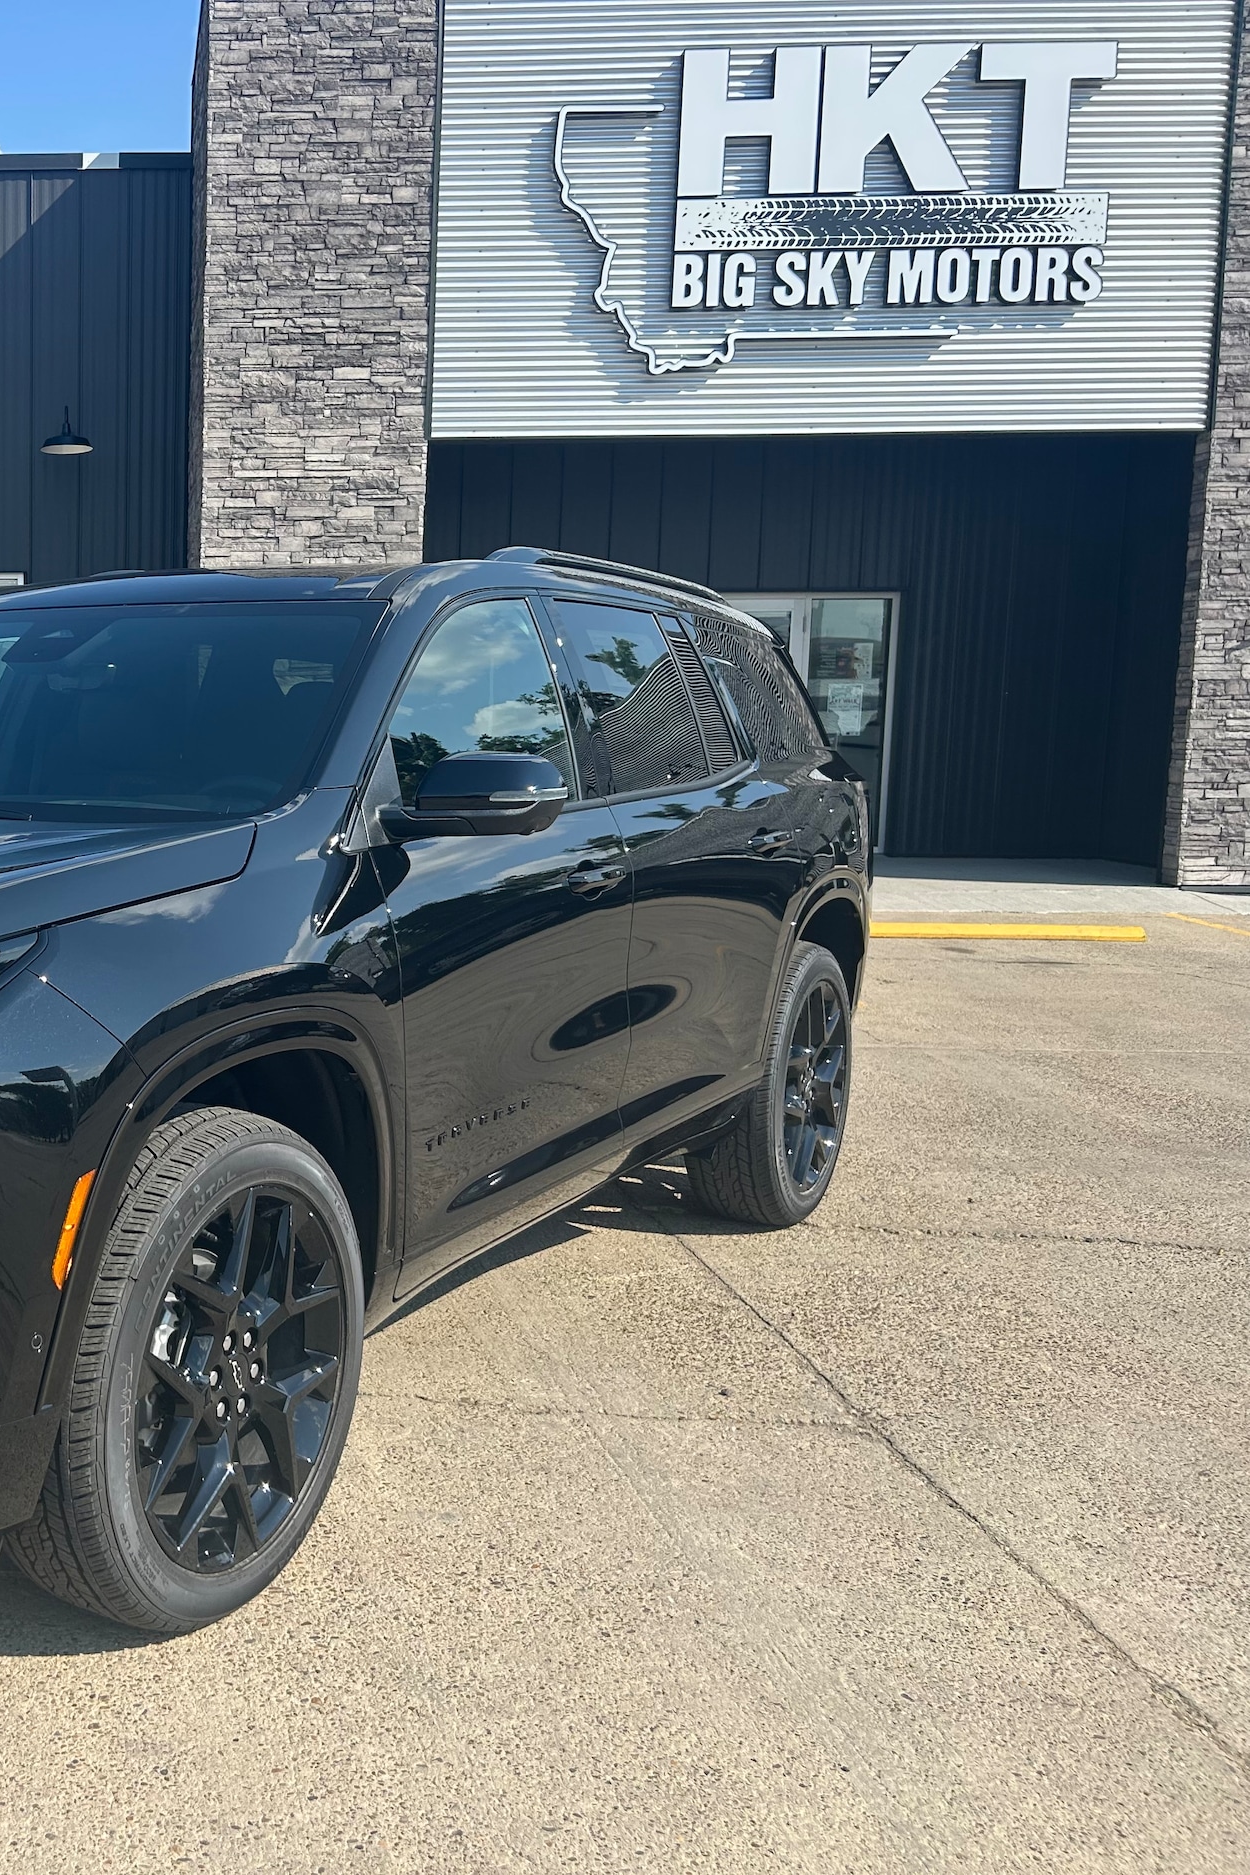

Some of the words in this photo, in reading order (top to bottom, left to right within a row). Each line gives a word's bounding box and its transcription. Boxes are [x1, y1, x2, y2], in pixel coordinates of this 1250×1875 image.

[676, 41, 1119, 197] HKT
[671, 252, 757, 309] BIG
[771, 249, 876, 307] SKY
[886, 245, 1104, 305] MOTORS
[425, 1097, 531, 1152] TRAVERSE
[134, 1170, 237, 1334] CONTINENTAL
